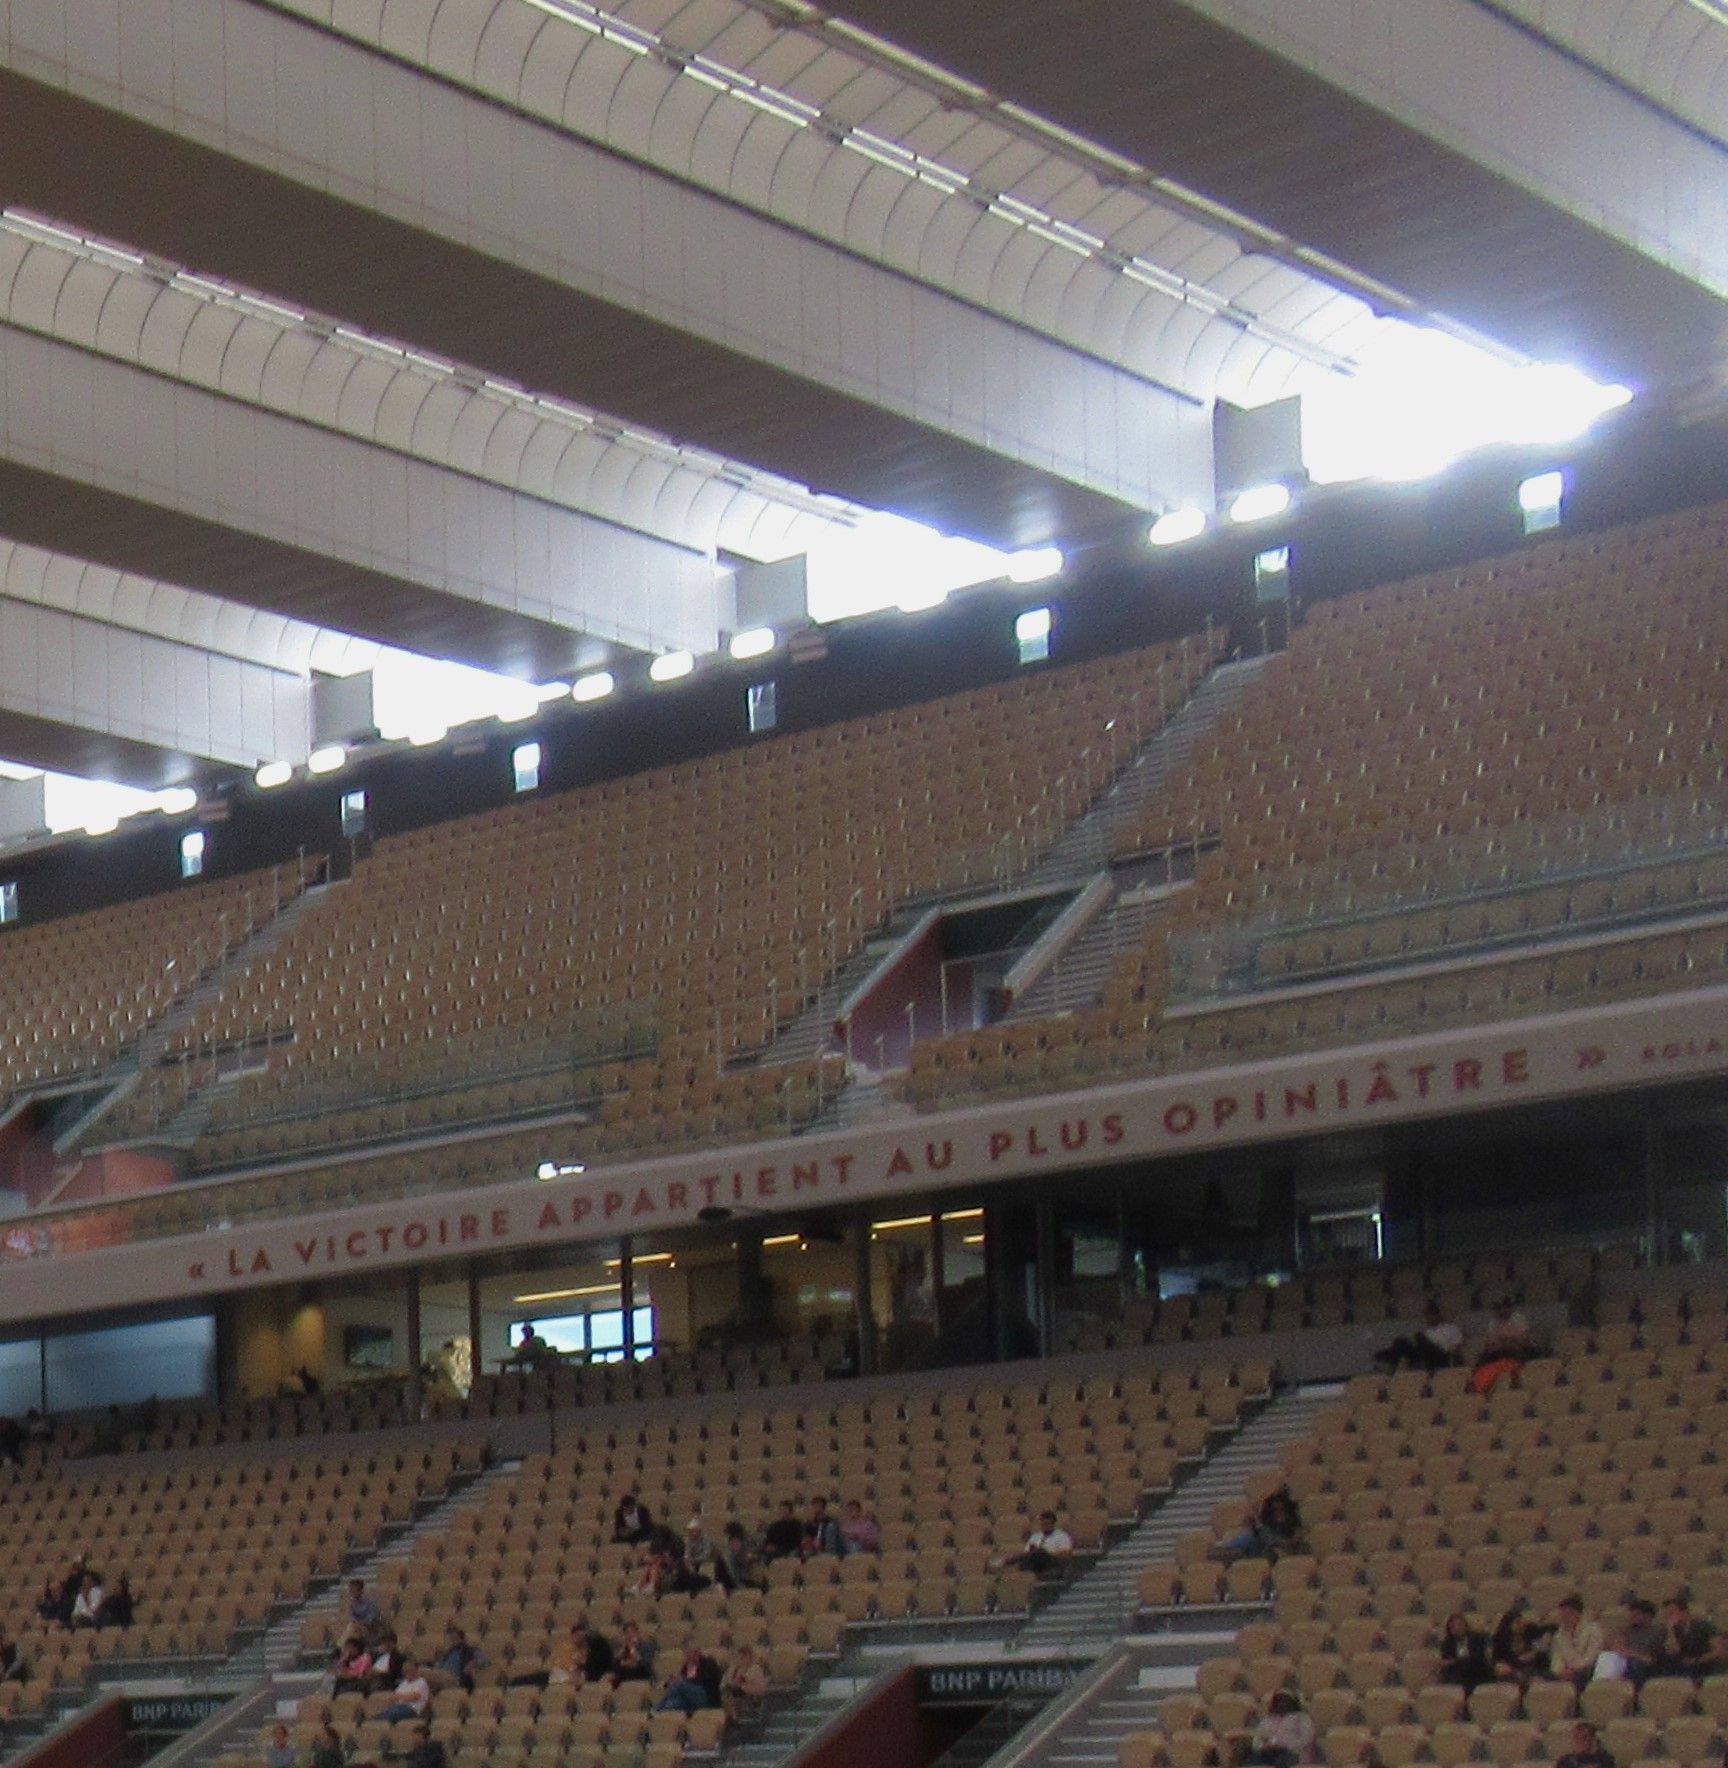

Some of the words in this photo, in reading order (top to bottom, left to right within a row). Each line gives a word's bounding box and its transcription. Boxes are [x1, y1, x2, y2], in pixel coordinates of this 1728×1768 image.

[228, 1249, 272, 1276] LA
[295, 1210, 510, 1265] VICTOIRE
[538, 1155, 854, 1230] APPARTIENT
[887, 1141, 952, 1177] AU
[988, 1115, 1125, 1161] PLUS
[1162, 1048, 1530, 1135] OPINIÂTRE
